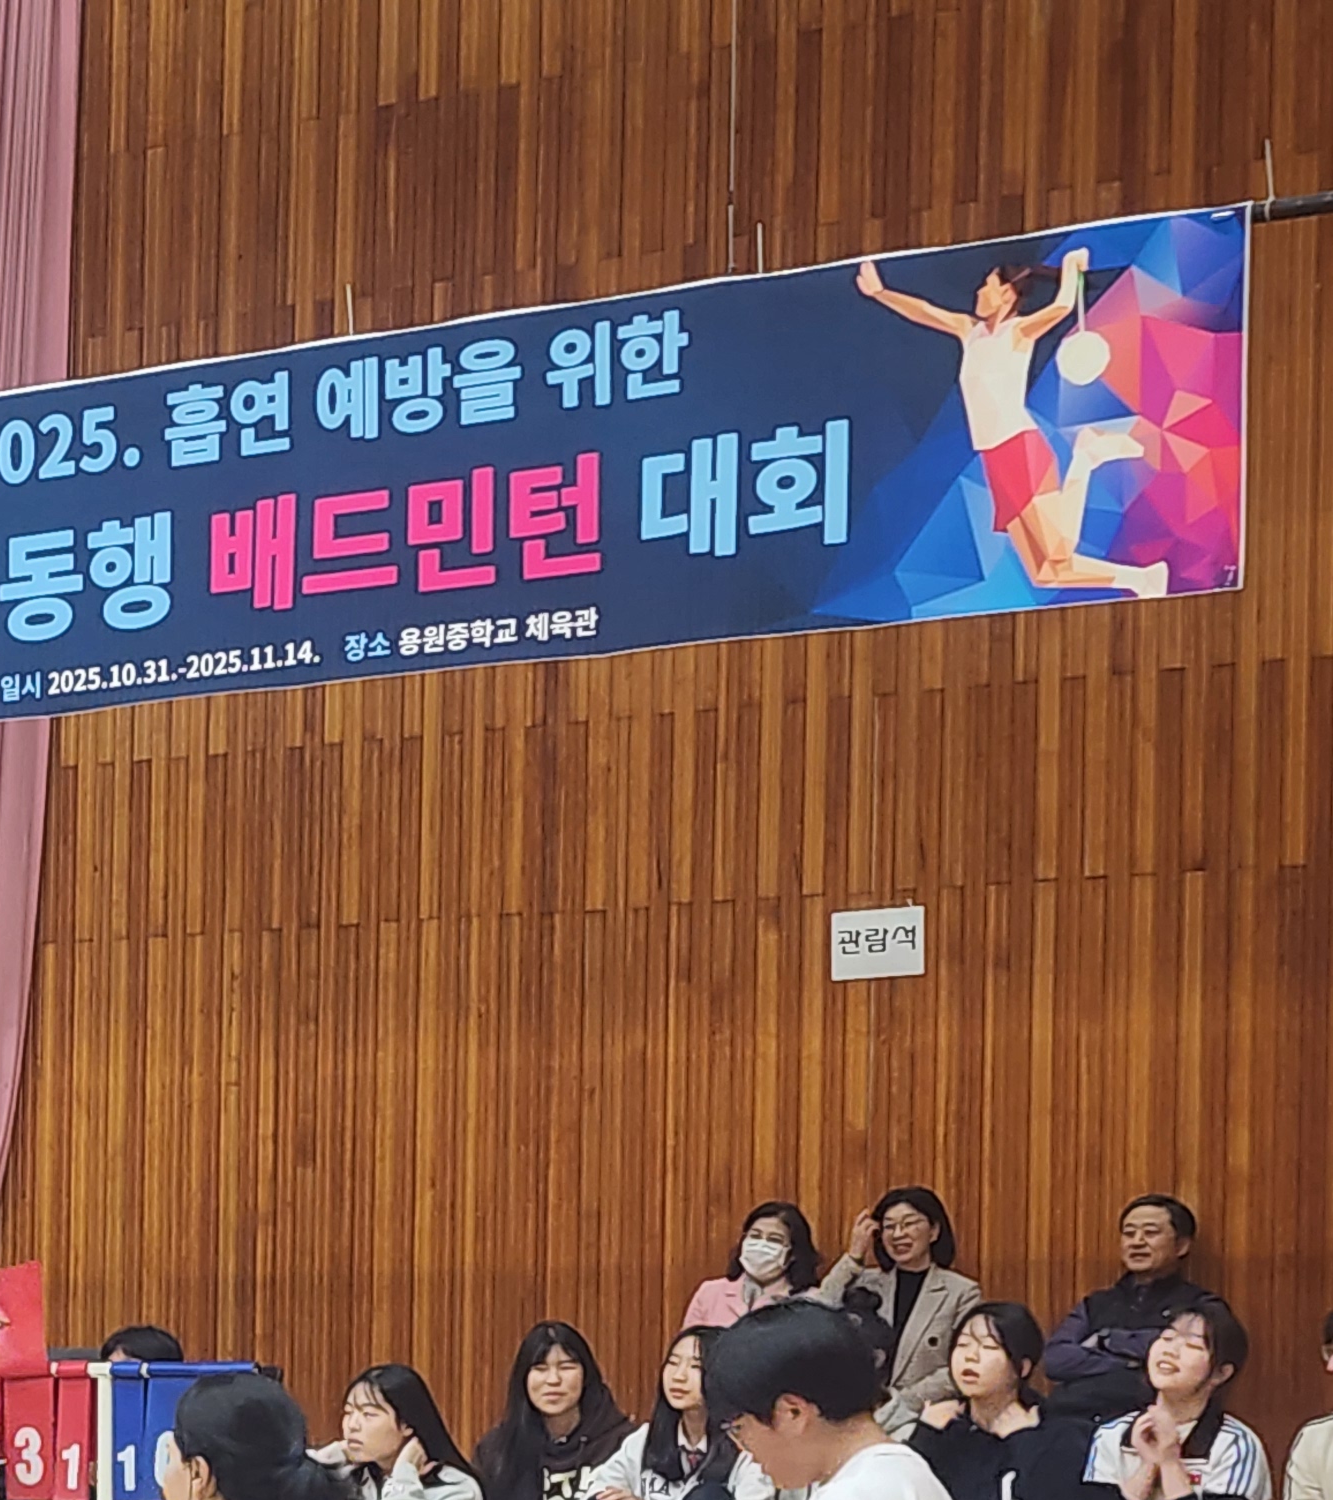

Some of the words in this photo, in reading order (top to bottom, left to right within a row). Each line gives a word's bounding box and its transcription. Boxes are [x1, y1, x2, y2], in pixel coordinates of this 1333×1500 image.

[164, 370, 292, 467] 흡연
[316, 338, 523, 439] 예방을
[546, 309, 689, 409] 위한
[208, 451, 602, 611] 배드민턴
[640, 418, 850, 556] 대회
[0, 670, 42, 702] 일시
[47, 638, 322, 695] 2025.10.31.-2025.11.14.
[344, 631, 392, 661] 장소
[398, 617, 519, 656] 용원중학교
[525, 606, 600, 641] 체육관
[837, 925, 917, 955] 관람석
[14, 1426, 44, 1486] 3
[61, 1443, 81, 1491] 1
[117, 1445, 136, 1491] 1
